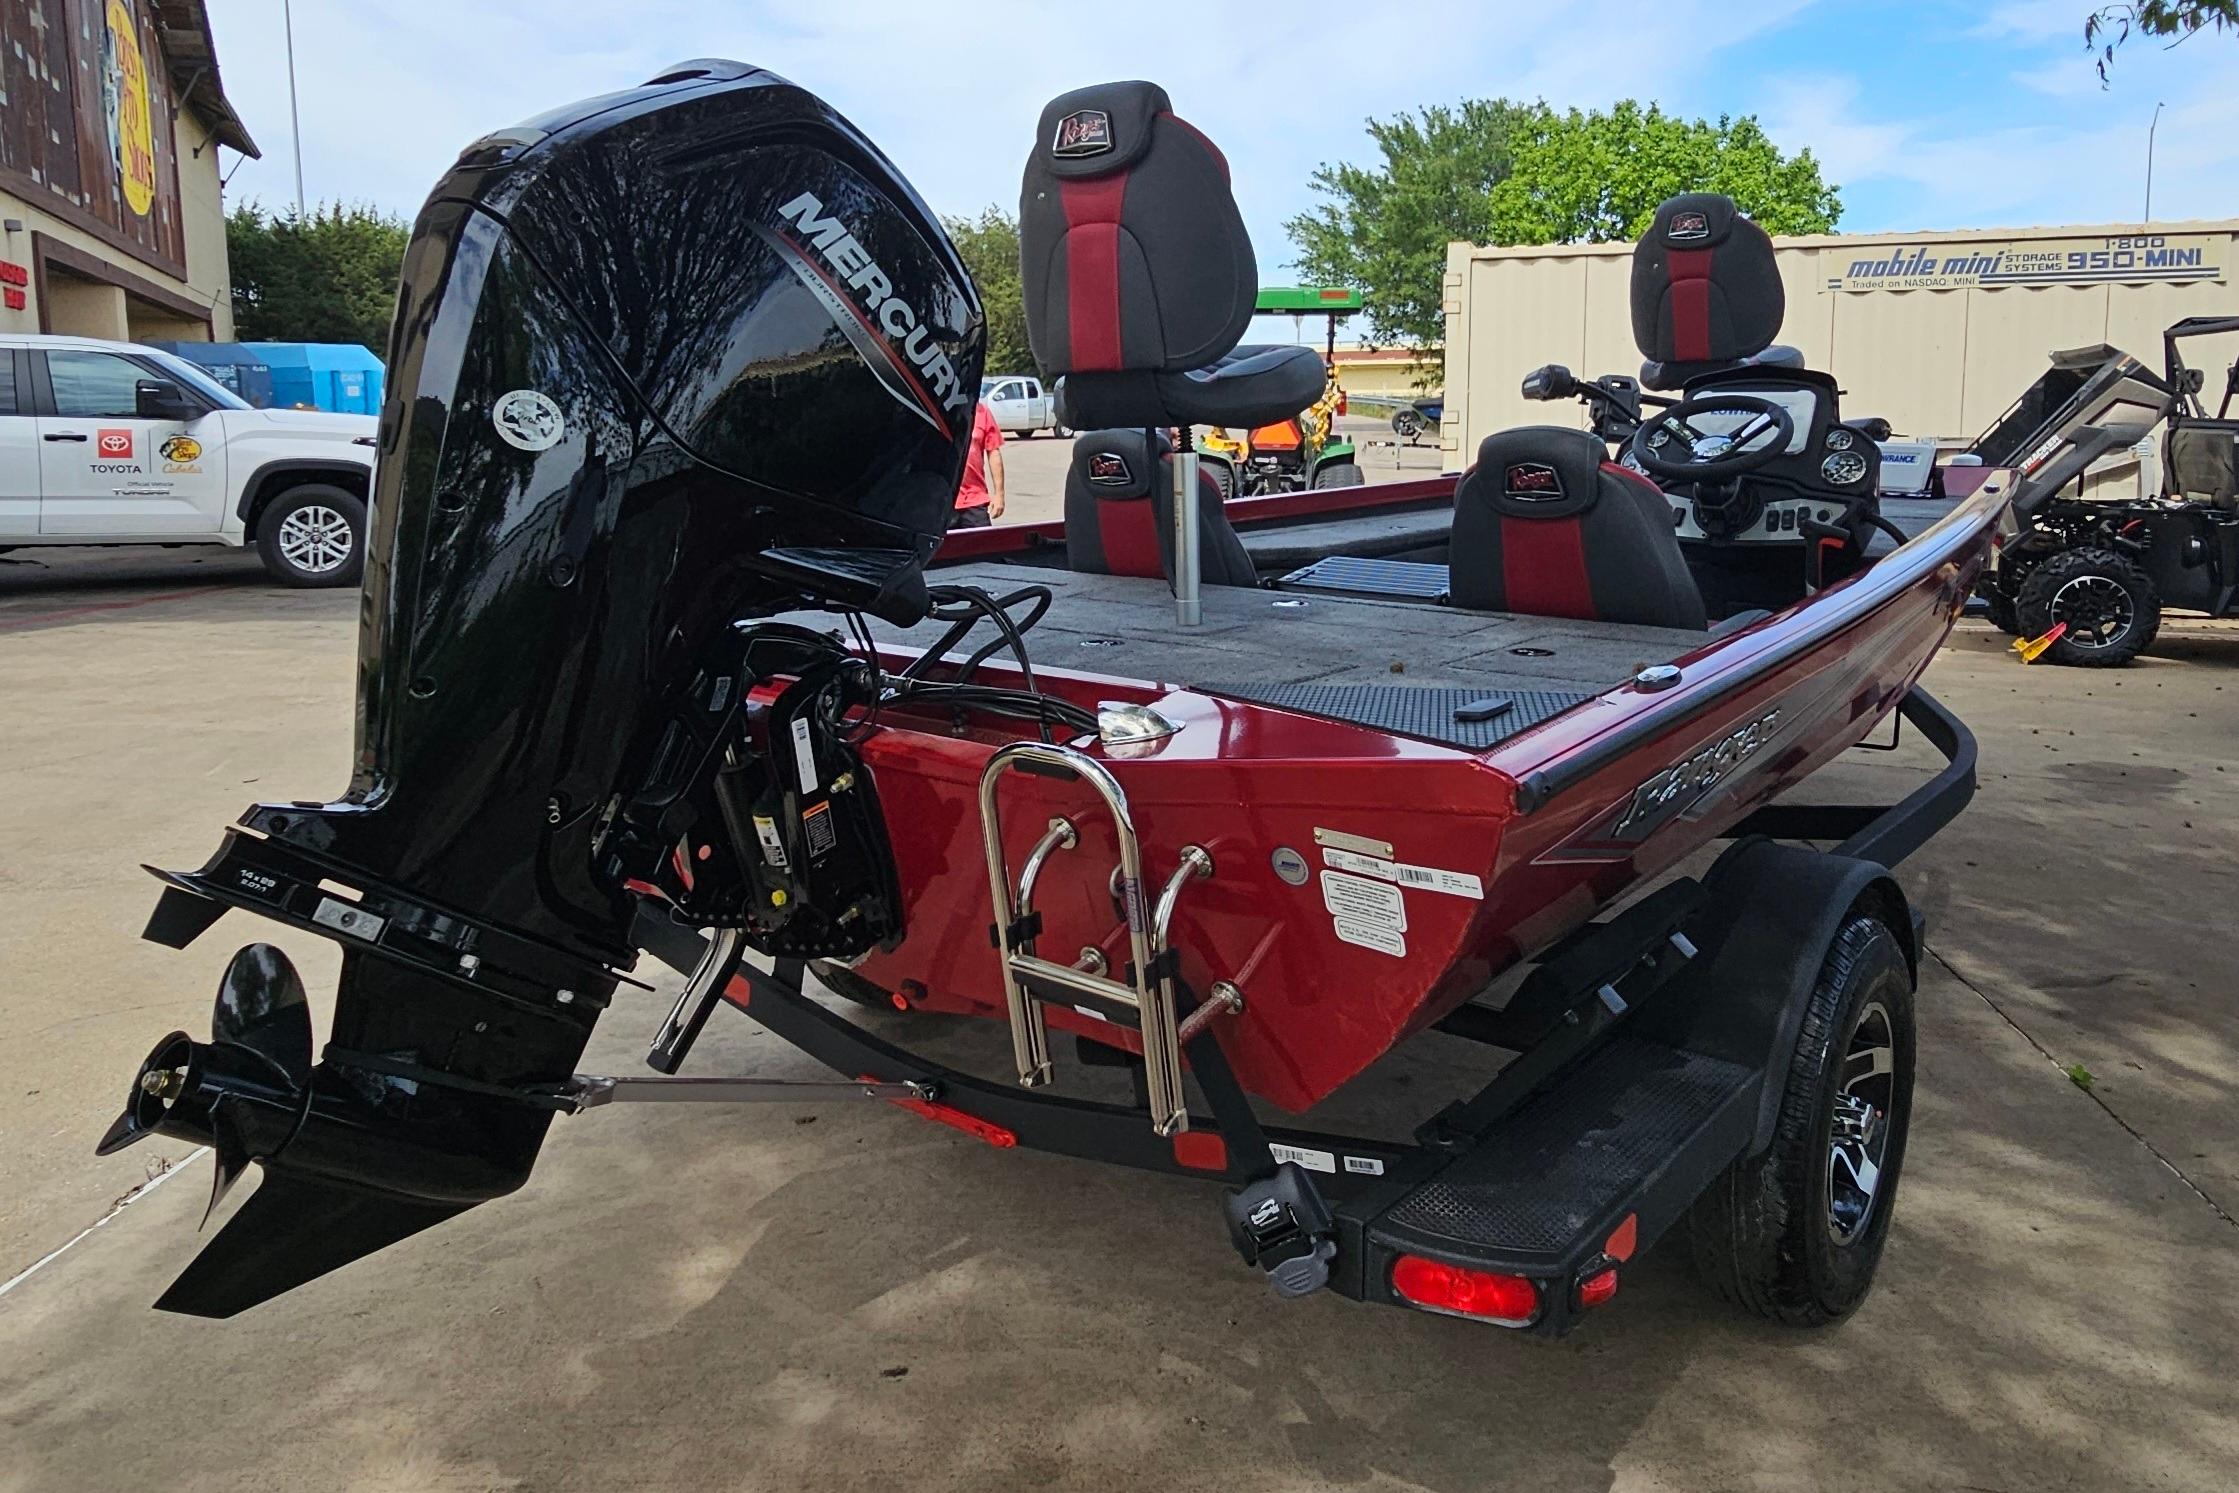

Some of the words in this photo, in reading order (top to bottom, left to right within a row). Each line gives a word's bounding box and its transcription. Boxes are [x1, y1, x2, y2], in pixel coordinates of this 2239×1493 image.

[1847, 247, 1937, 279] mobile
[1940, 249, 2005, 275] mini
[2005, 252, 2063, 263] STORAGE
[2067, 247, 2202, 270] 950-MINI
[2005, 262, 2063, 273] SYSTEMS
[1852, 279, 1884, 290] Traded
[1888, 280, 1901, 289] on
[1953, 276, 1976, 287] MINI
[778, 191, 970, 412] MERCURY
[89, 464, 142, 474] TOYOTA
